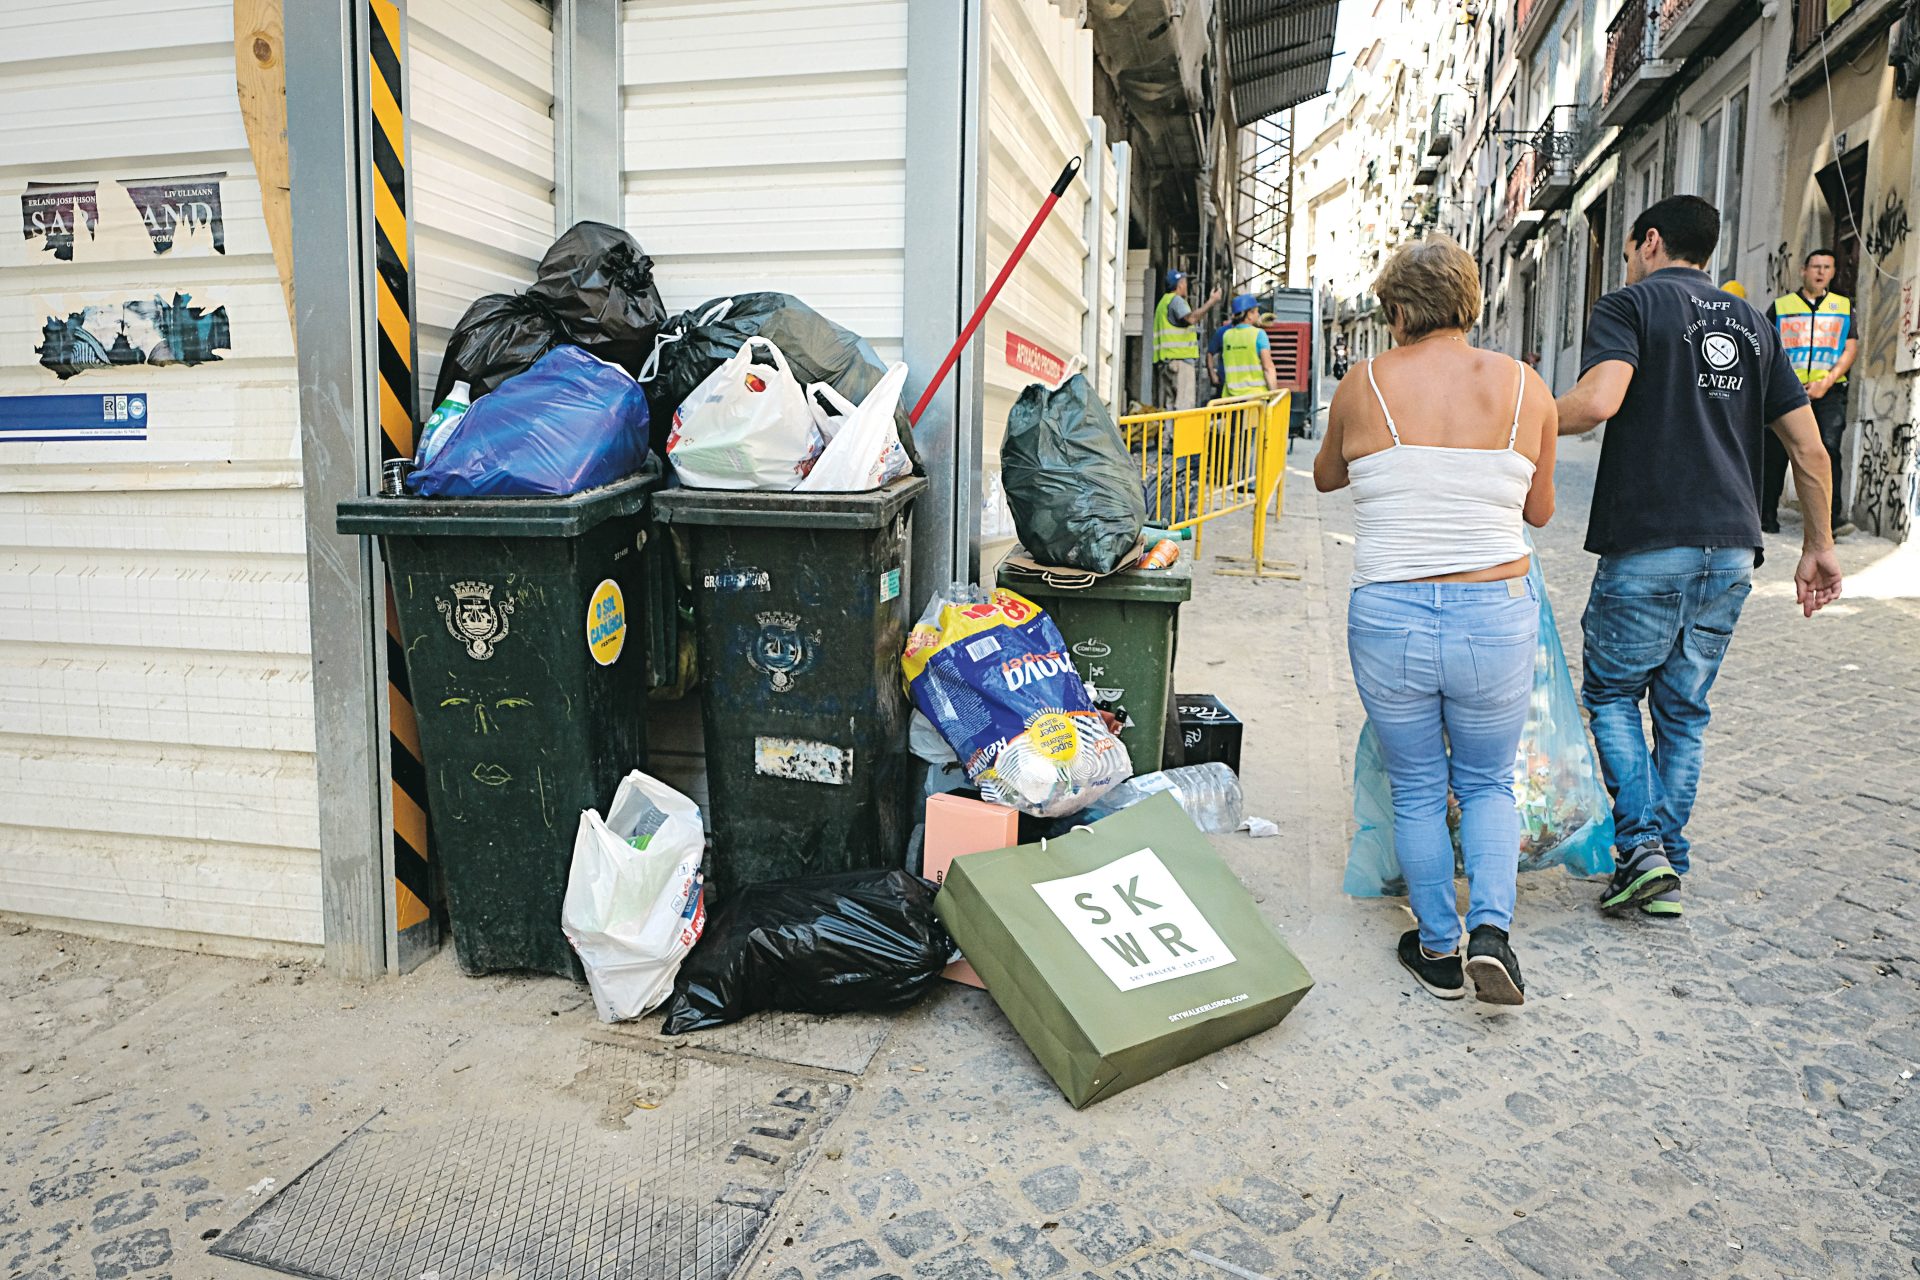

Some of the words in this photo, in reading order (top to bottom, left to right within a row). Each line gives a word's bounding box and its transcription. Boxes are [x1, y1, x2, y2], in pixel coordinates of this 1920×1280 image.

[164, 190, 177, 198] LIV
[177, 188, 213, 198] ULLMANN
[28, 197, 55, 207] ERLAND
[1691, 295, 1731, 311] STAFF
[1697, 373, 1744, 391] ENERI
[1040, 722, 1066, 738] super
[1146, 965, 1177, 977] WALKER
[1168, 993, 1249, 1022] SKYWALKERLISBON.COM
